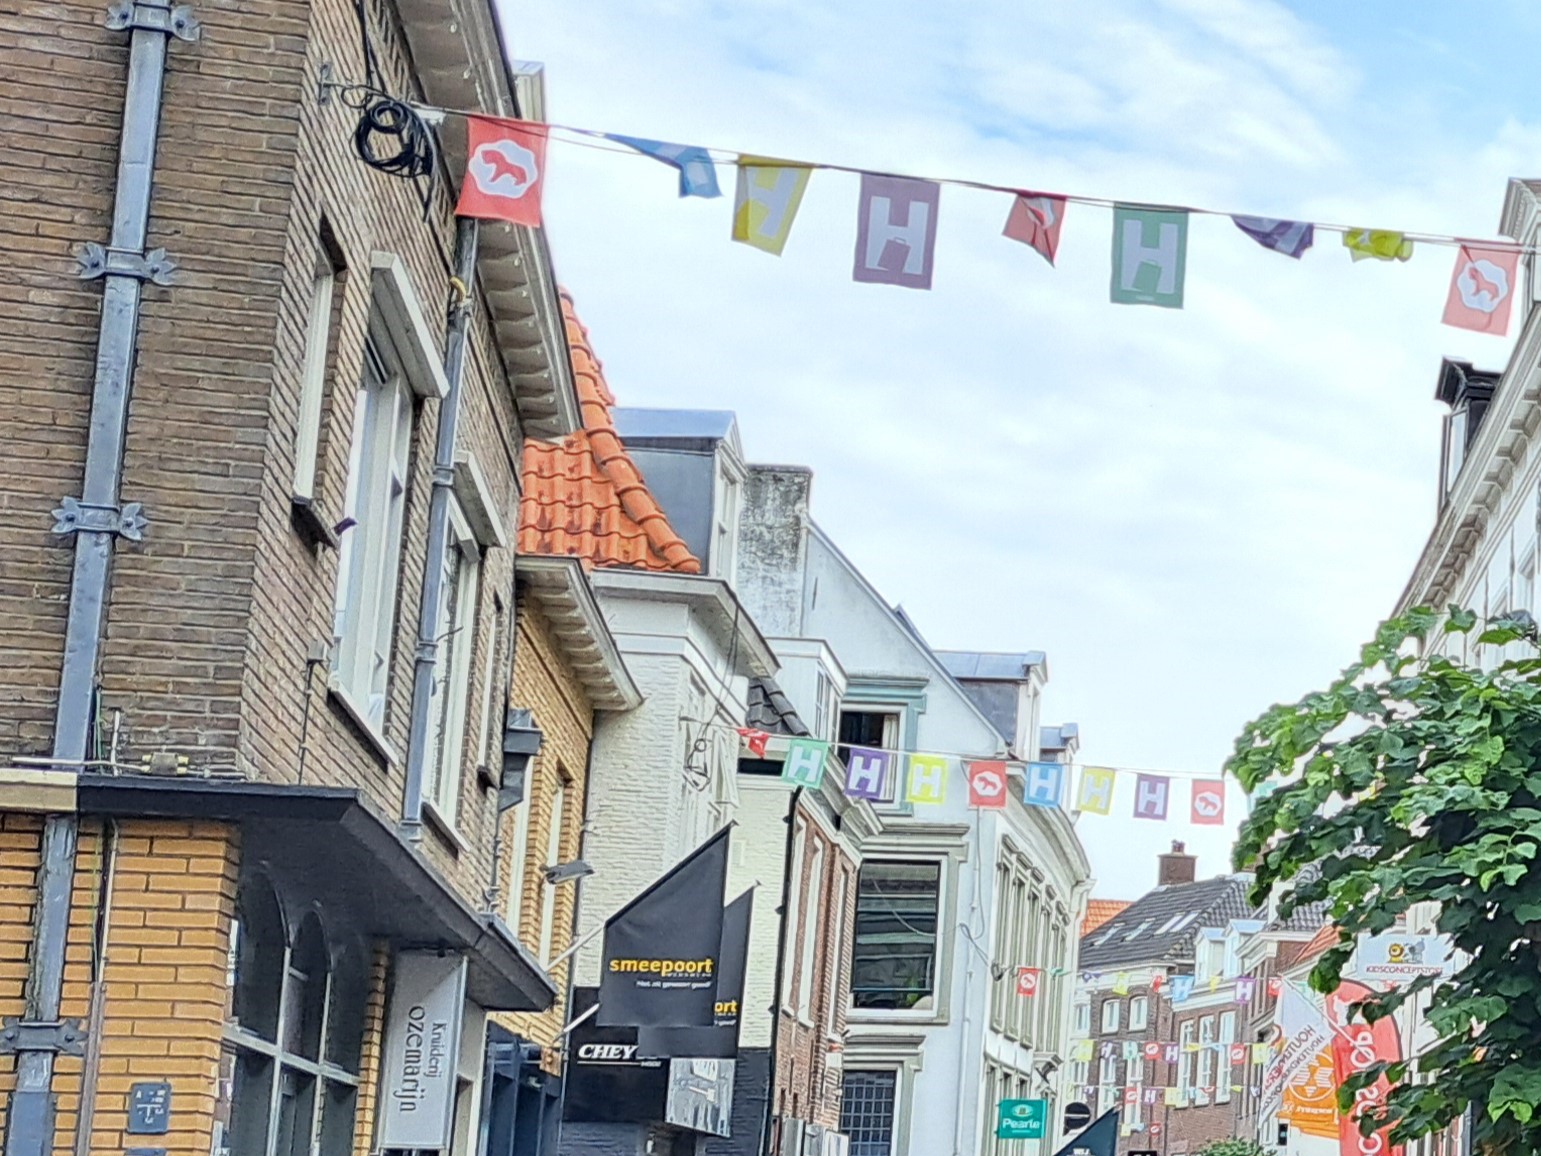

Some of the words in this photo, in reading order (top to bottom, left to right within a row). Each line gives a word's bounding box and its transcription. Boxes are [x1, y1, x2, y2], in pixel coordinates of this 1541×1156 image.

[789, 746, 824, 782] H
[848, 755, 883, 793] H
[912, 764, 942, 797] H
[1029, 764, 1060, 801] H
[1138, 782, 1165, 814] H
[609, 958, 713, 977] smeepoort
[1002, 1117, 1041, 1129] Pearle
